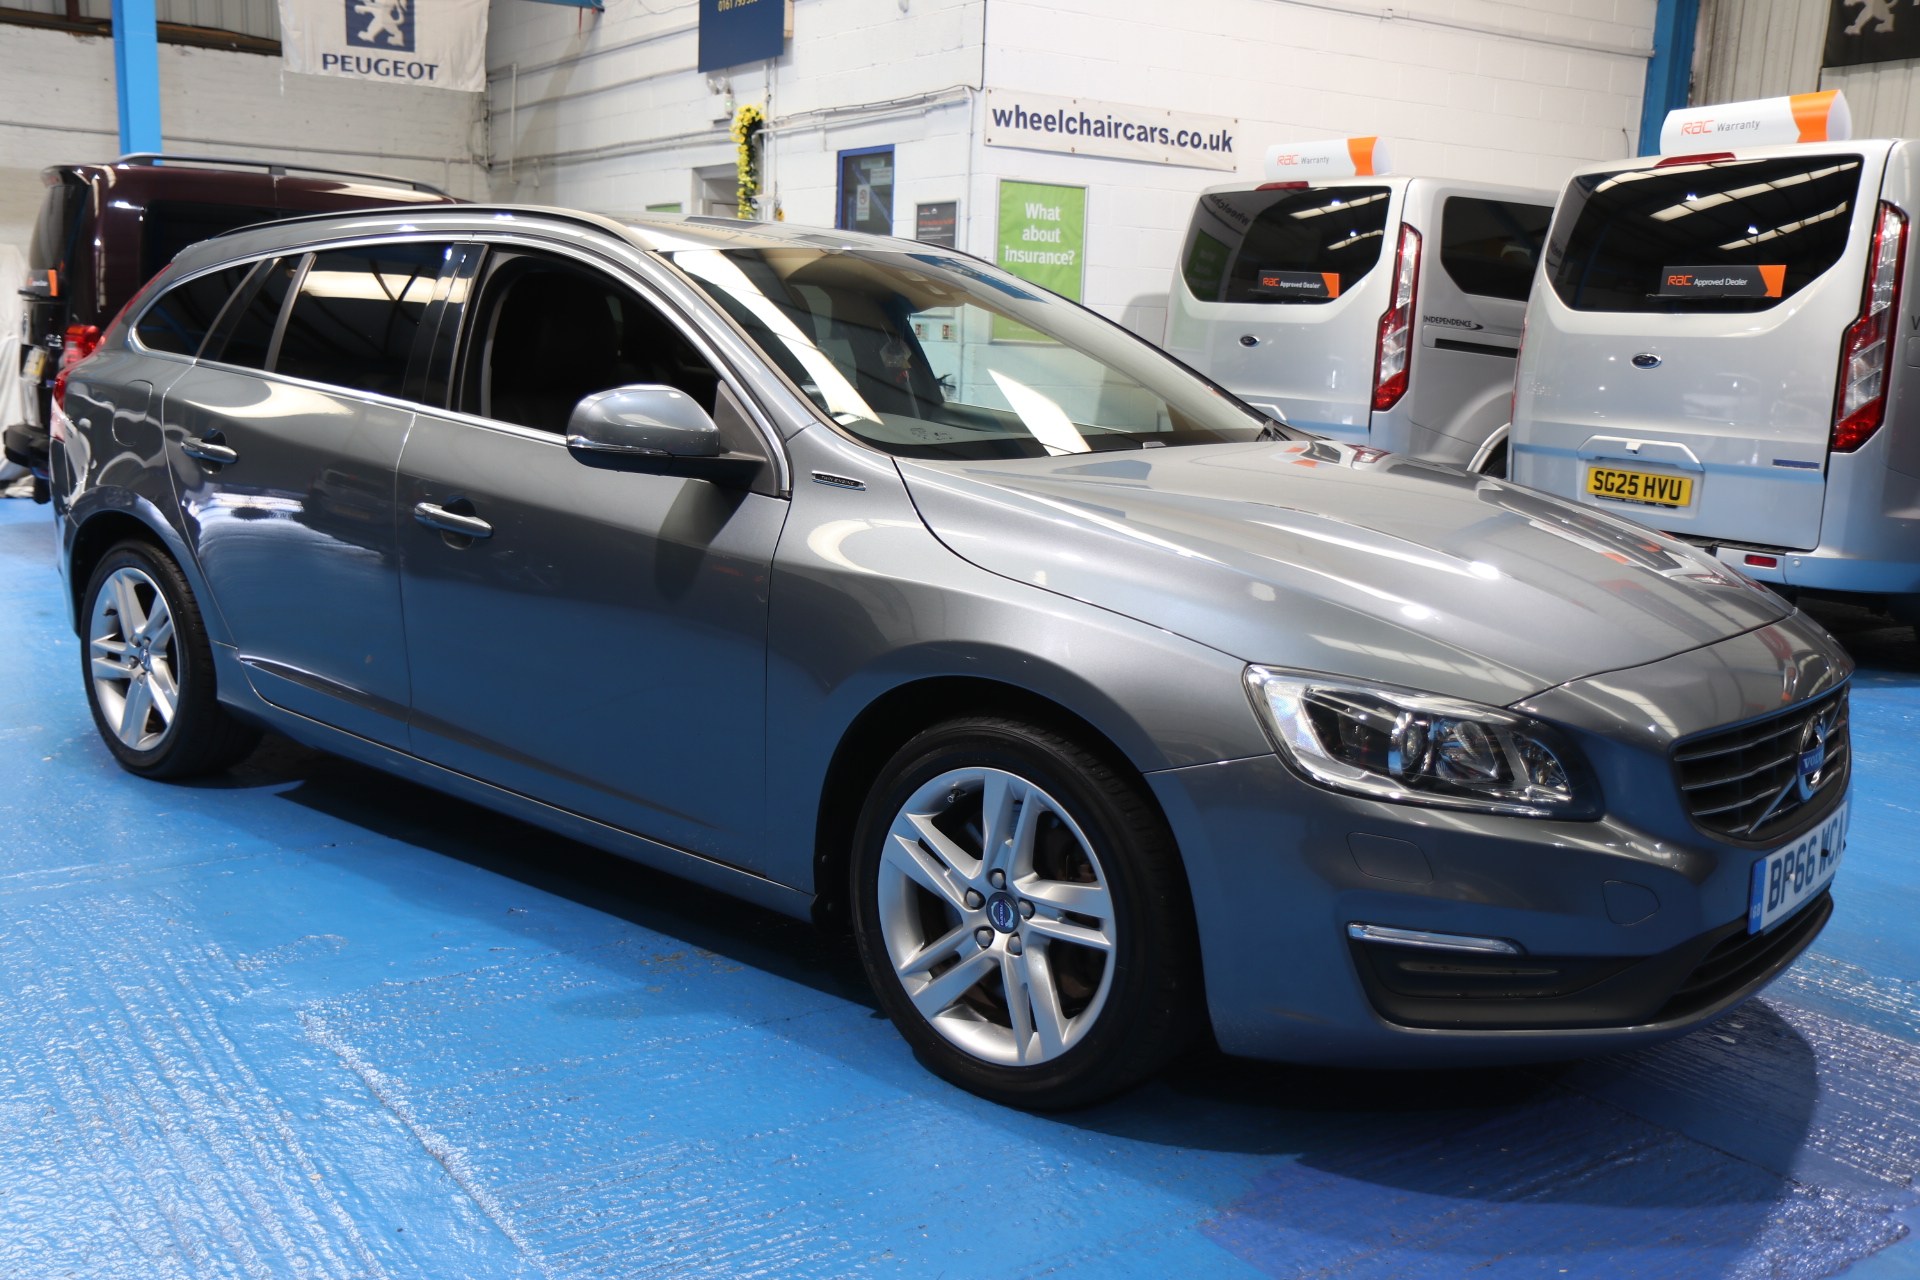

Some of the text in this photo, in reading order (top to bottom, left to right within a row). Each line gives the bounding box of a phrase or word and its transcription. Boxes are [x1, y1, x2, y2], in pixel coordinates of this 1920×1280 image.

[322, 53, 439, 80] PEUGEOT
[992, 104, 1233, 153] wheelchaircars.co.uk
[1717, 120, 1760, 132] Warranty
[1300, 156, 1329, 165] Warranty
[1025, 202, 1061, 221] What
[1022, 225, 1061, 243] about
[1004, 245, 1075, 266] insurance?
[1280, 280, 1302, 289] Approved
[1302, 281, 1320, 289] Dealer
[1693, 278, 1724, 287] Approved
[1724, 278, 1748, 286] Dealer
[1423, 315, 1472, 328] INDEPENDENCE
[1593, 470, 1682, 501] SG25 HVU
[1767, 834, 1818, 913] BP66
